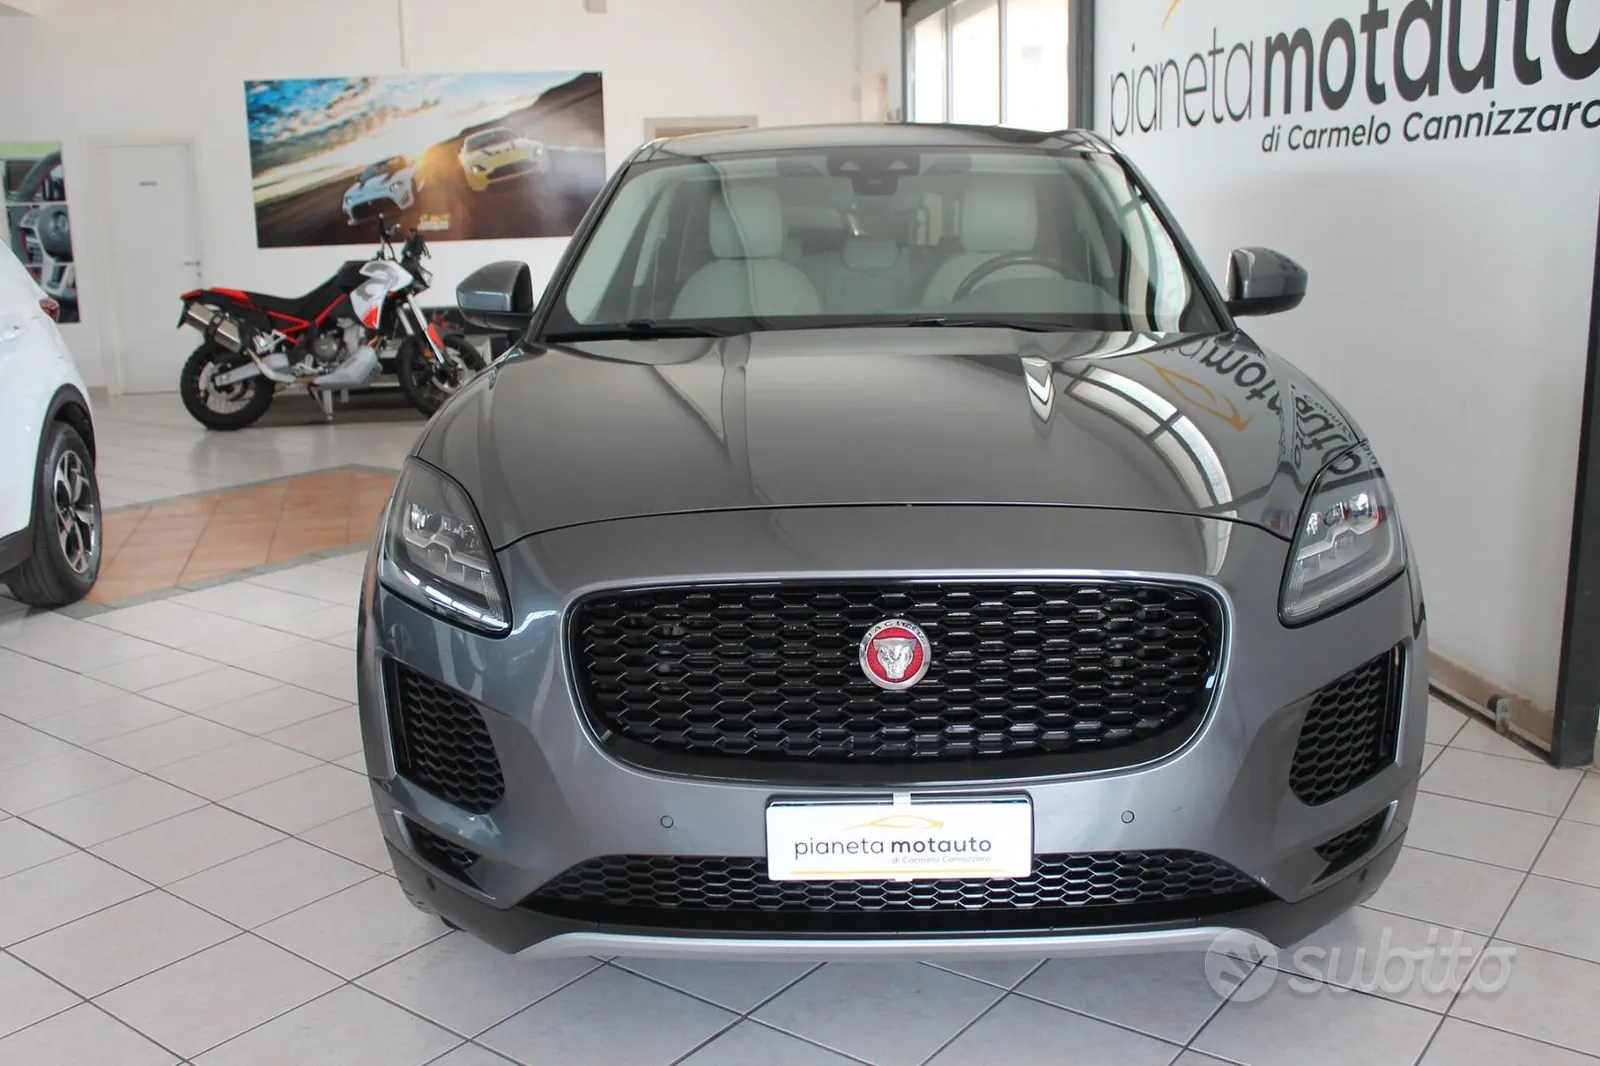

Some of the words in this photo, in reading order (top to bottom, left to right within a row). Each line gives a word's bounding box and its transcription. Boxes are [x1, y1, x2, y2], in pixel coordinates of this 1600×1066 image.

[1110, 26, 1253, 144] pianeta
[1261, 124, 1280, 153] di
[1288, 115, 1391, 150] Carmelo
[1403, 99, 1600, 142] Cannizzaro
[795, 837, 884, 861] pianeta
[891, 837, 992, 853] motauto
